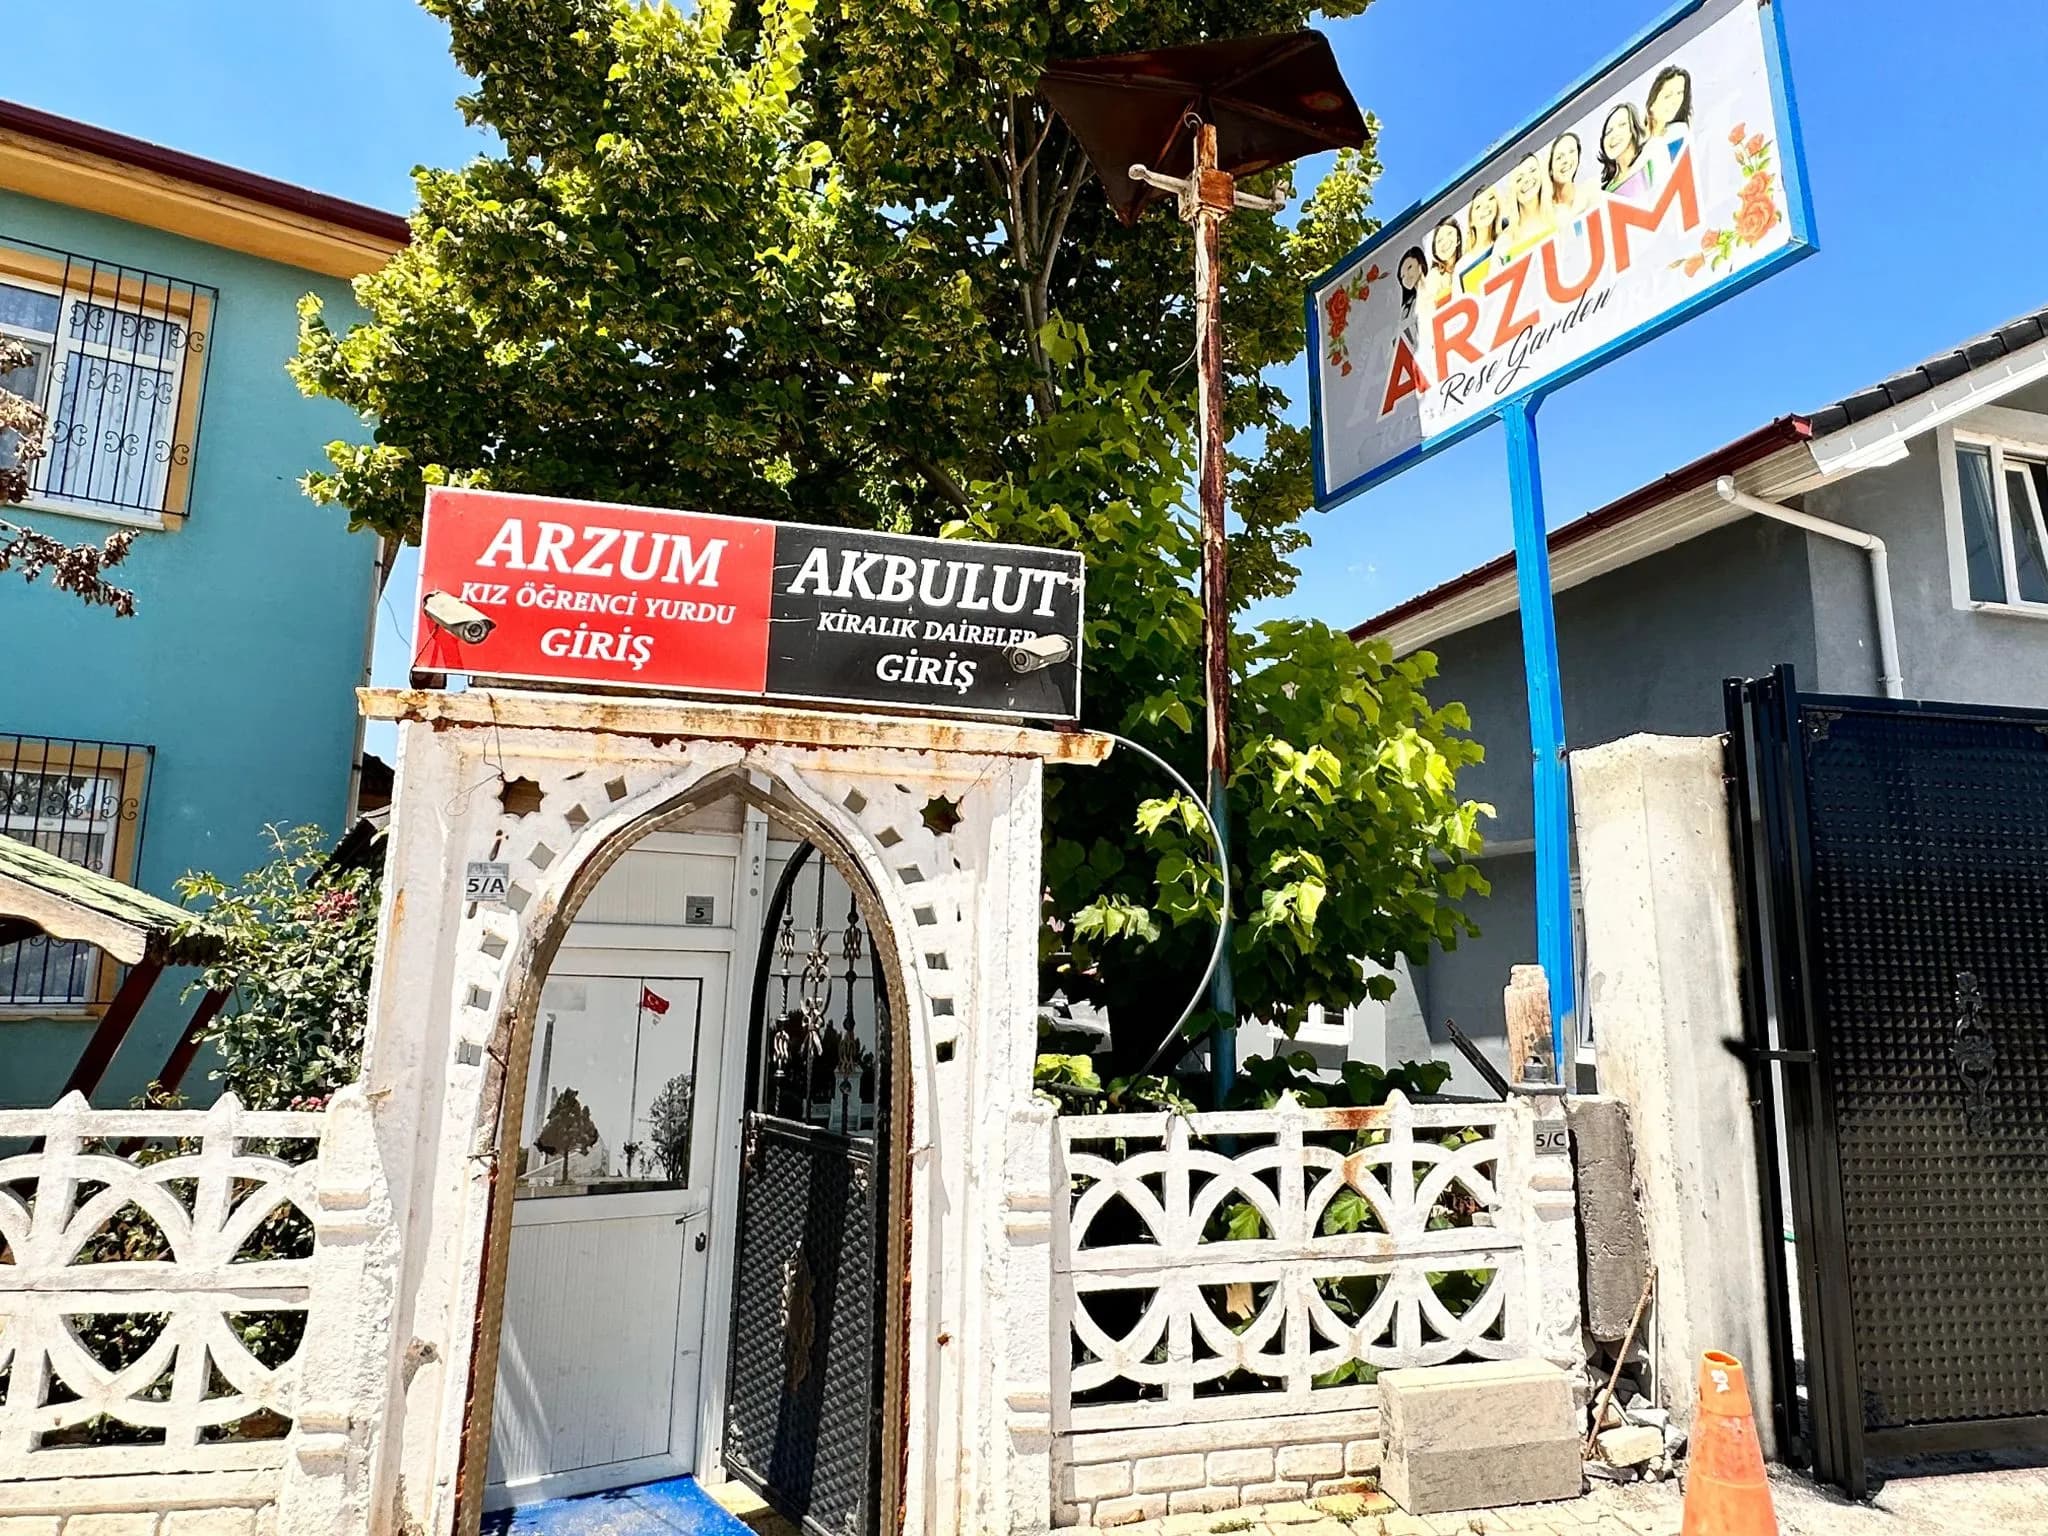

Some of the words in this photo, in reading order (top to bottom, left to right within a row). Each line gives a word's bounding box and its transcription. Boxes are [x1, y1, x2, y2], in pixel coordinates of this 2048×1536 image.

[1382, 144, 1700, 416] ARZUM
[1440, 359, 1501, 411] Rose
[1494, 284, 1616, 395] Garden
[475, 517, 729, 588] ARZUM
[460, 581, 511, 605] KIZ
[515, 581, 638, 616] ÖĞRENCİ
[645, 597, 737, 625] YURDU
[786, 546, 1068, 617] AKBULUT
[540, 621, 655, 671] GİRİŞ
[816, 607, 920, 639] KİRALIK
[875, 647, 978, 695] GİRİŞ
[467, 877, 505, 894] 5/A
[695, 907, 705, 918] 5
[1535, 1132, 1565, 1148] 5/C
